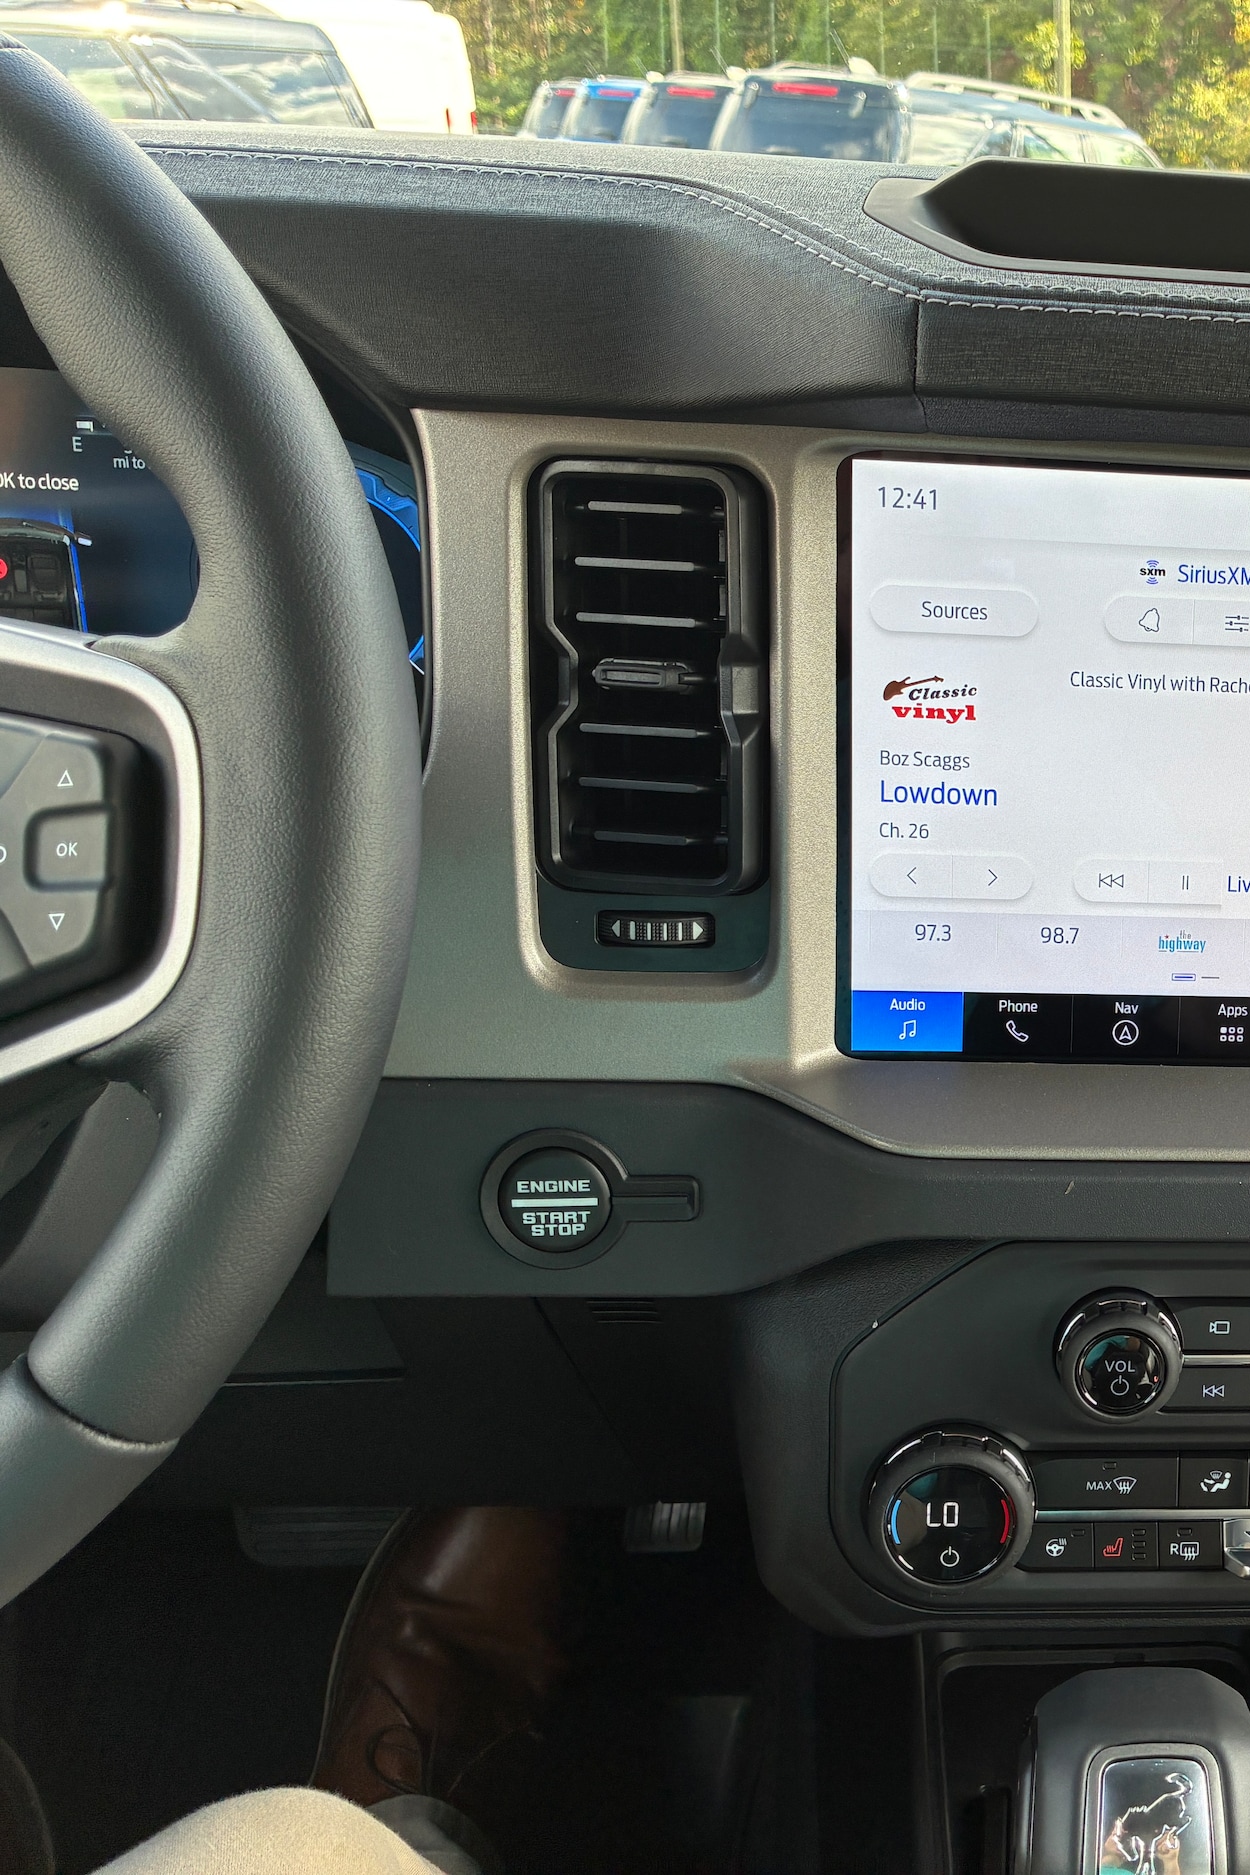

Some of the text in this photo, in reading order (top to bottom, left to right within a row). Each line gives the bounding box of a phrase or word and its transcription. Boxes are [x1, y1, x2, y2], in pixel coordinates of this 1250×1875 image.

[72, 437, 83, 452] E
[113, 456, 145, 469] mi to
[17, 473, 35, 489] to
[38, 473, 79, 491] close
[878, 486, 938, 510] 12:41
[1139, 565, 1166, 577] sxm
[921, 601, 988, 621] Sources
[1070, 671, 1123, 690] Classic
[1128, 673, 1166, 693] Vinyl
[1170, 674, 1206, 692] with
[908, 684, 977, 702] Classic
[892, 704, 976, 724] vinyl
[880, 750, 970, 771] Boz Scaggs
[880, 780, 998, 806] Lowdown
[879, 822, 930, 840] Ch. 26
[56, 842, 78, 857] OK
[915, 924, 952, 943] 97.3
[1040, 927, 1080, 945] 98.7
[1158, 935, 1206, 953] highway
[889, 998, 926, 1012] Audio
[998, 999, 1038, 1014] Phone
[1115, 1001, 1139, 1015] Nav
[1218, 1004, 1248, 1019] Apps
[516, 1180, 591, 1193] ENGINE
[522, 1211, 590, 1223] START
[531, 1224, 585, 1237] STOP
[1105, 1360, 1136, 1374] VOL
[1086, 1481, 1112, 1491] MAX
[926, 1502, 959, 1528] LO
